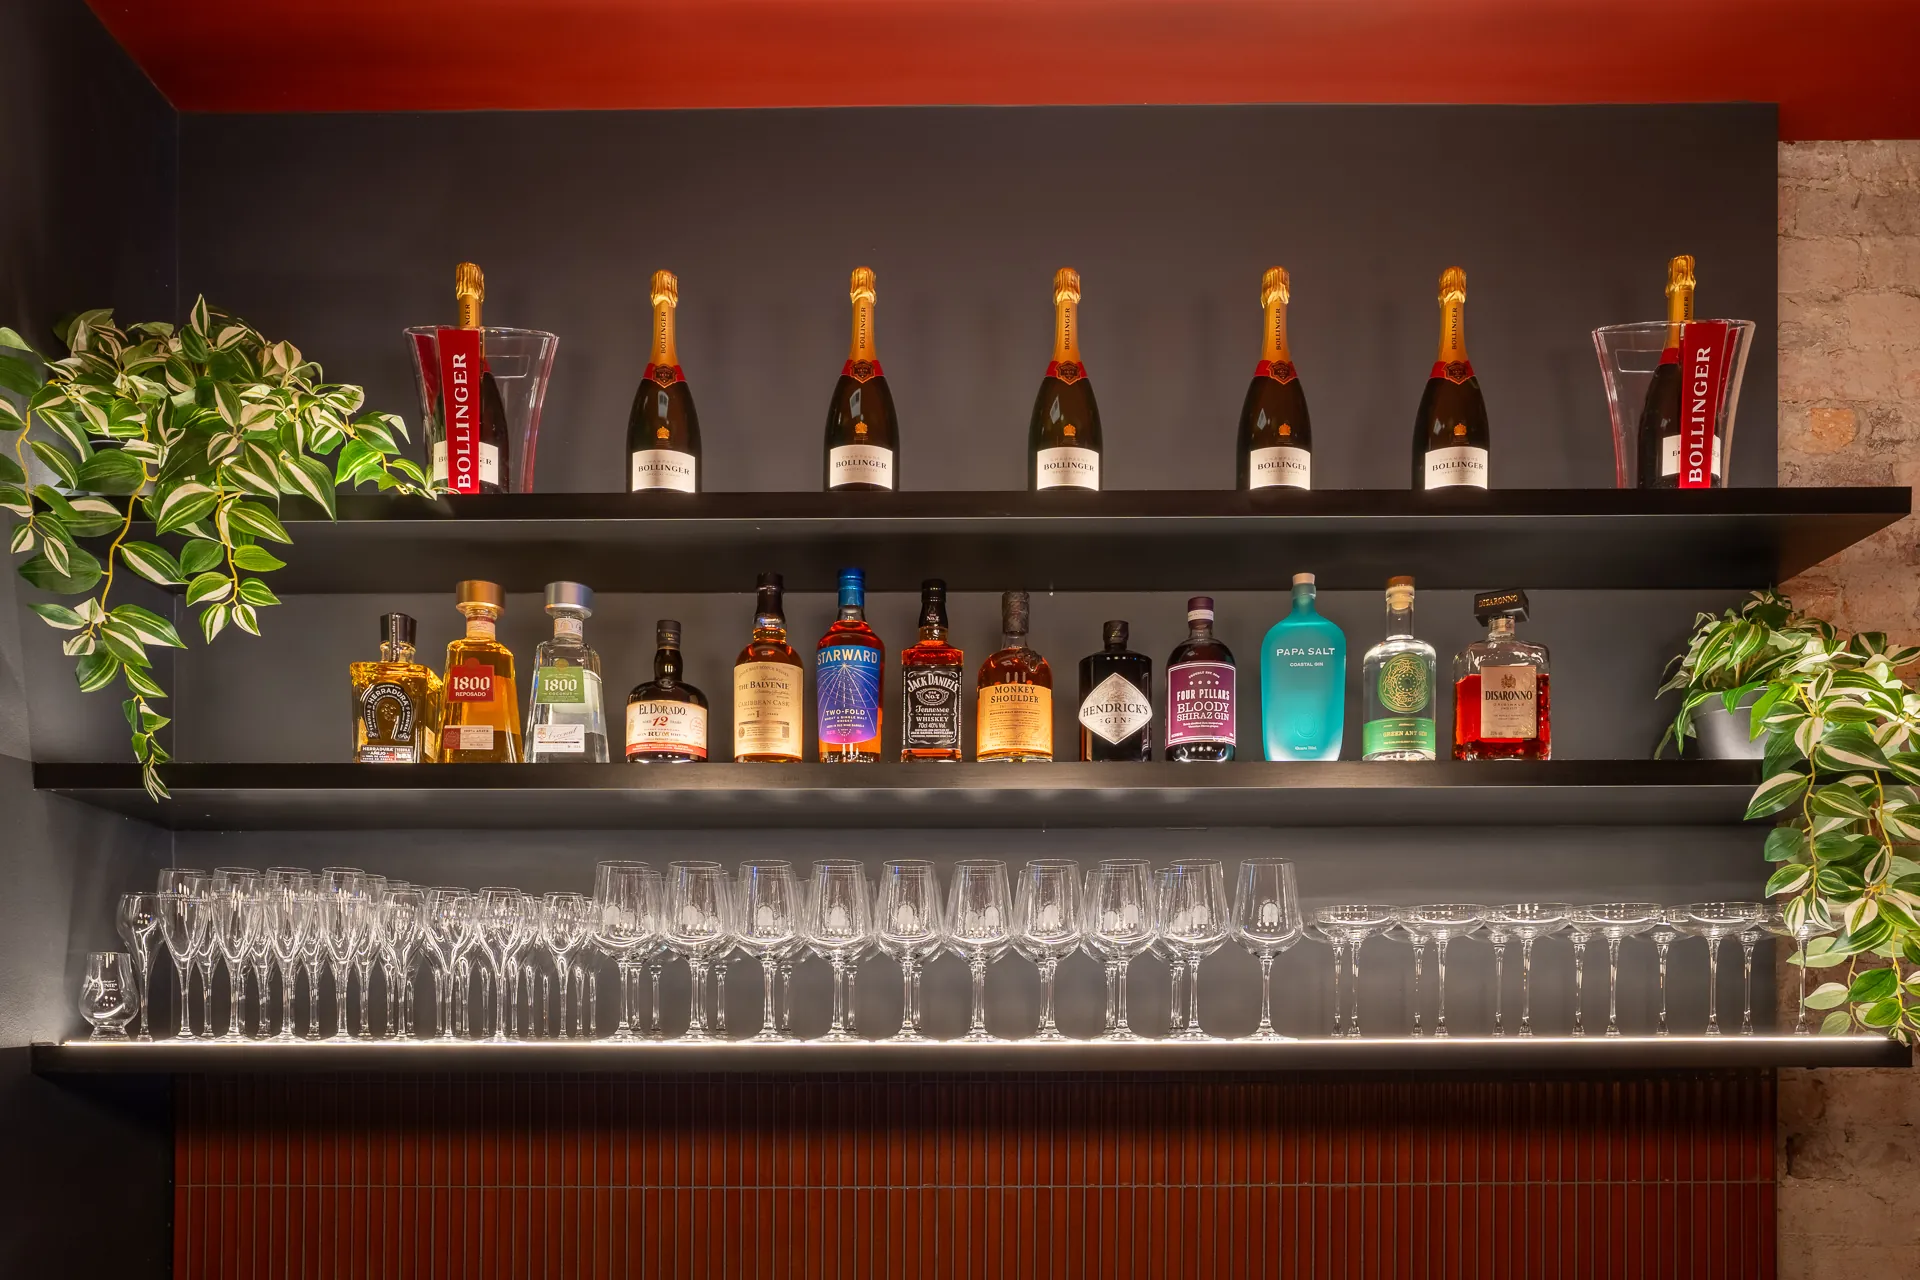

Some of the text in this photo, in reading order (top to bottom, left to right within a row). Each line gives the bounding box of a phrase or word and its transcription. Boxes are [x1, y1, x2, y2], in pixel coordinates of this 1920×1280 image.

[453, 353, 472, 488] BOLLINGER
[1688, 347, 1711, 483] BOLLINGER
[638, 464, 690, 475] BOLLINGER
[835, 460, 887, 470] BOLLINGER
[1043, 462, 1094, 472] BOLLINGER
[1257, 461, 1307, 472] BOLLINGER
[1432, 461, 1484, 471] BOLLINGER
[1478, 594, 1518, 607] DISARONNO
[1276, 647, 1336, 656] PAPA SALT
[817, 649, 878, 666] STARWARD
[453, 676, 490, 691] 1800
[544, 679, 578, 692] 1800
[750, 680, 789, 690] BALVENIE
[907, 673, 960, 693] JACK DANIEL'S
[994, 686, 1036, 695] MONKEY
[1176, 688, 1230, 702] FOUR PILLARS
[1485, 690, 1533, 701] DISARONNO
[367, 687, 410, 706] HERRADURA
[990, 695, 1039, 704] SHOULDER
[639, 703, 687, 716] EL DORADO
[738, 700, 790, 708] CARIBBEAN CASK
[915, 704, 950, 713] Tennessee
[1083, 702, 1149, 717] HENDRICK'S
[1176, 701, 1230, 714] BLOODY
[825, 708, 866, 716] TWO-FOLD
[1176, 712, 1230, 722] SHIRAZ GIN
[652, 715, 669, 727] 12
